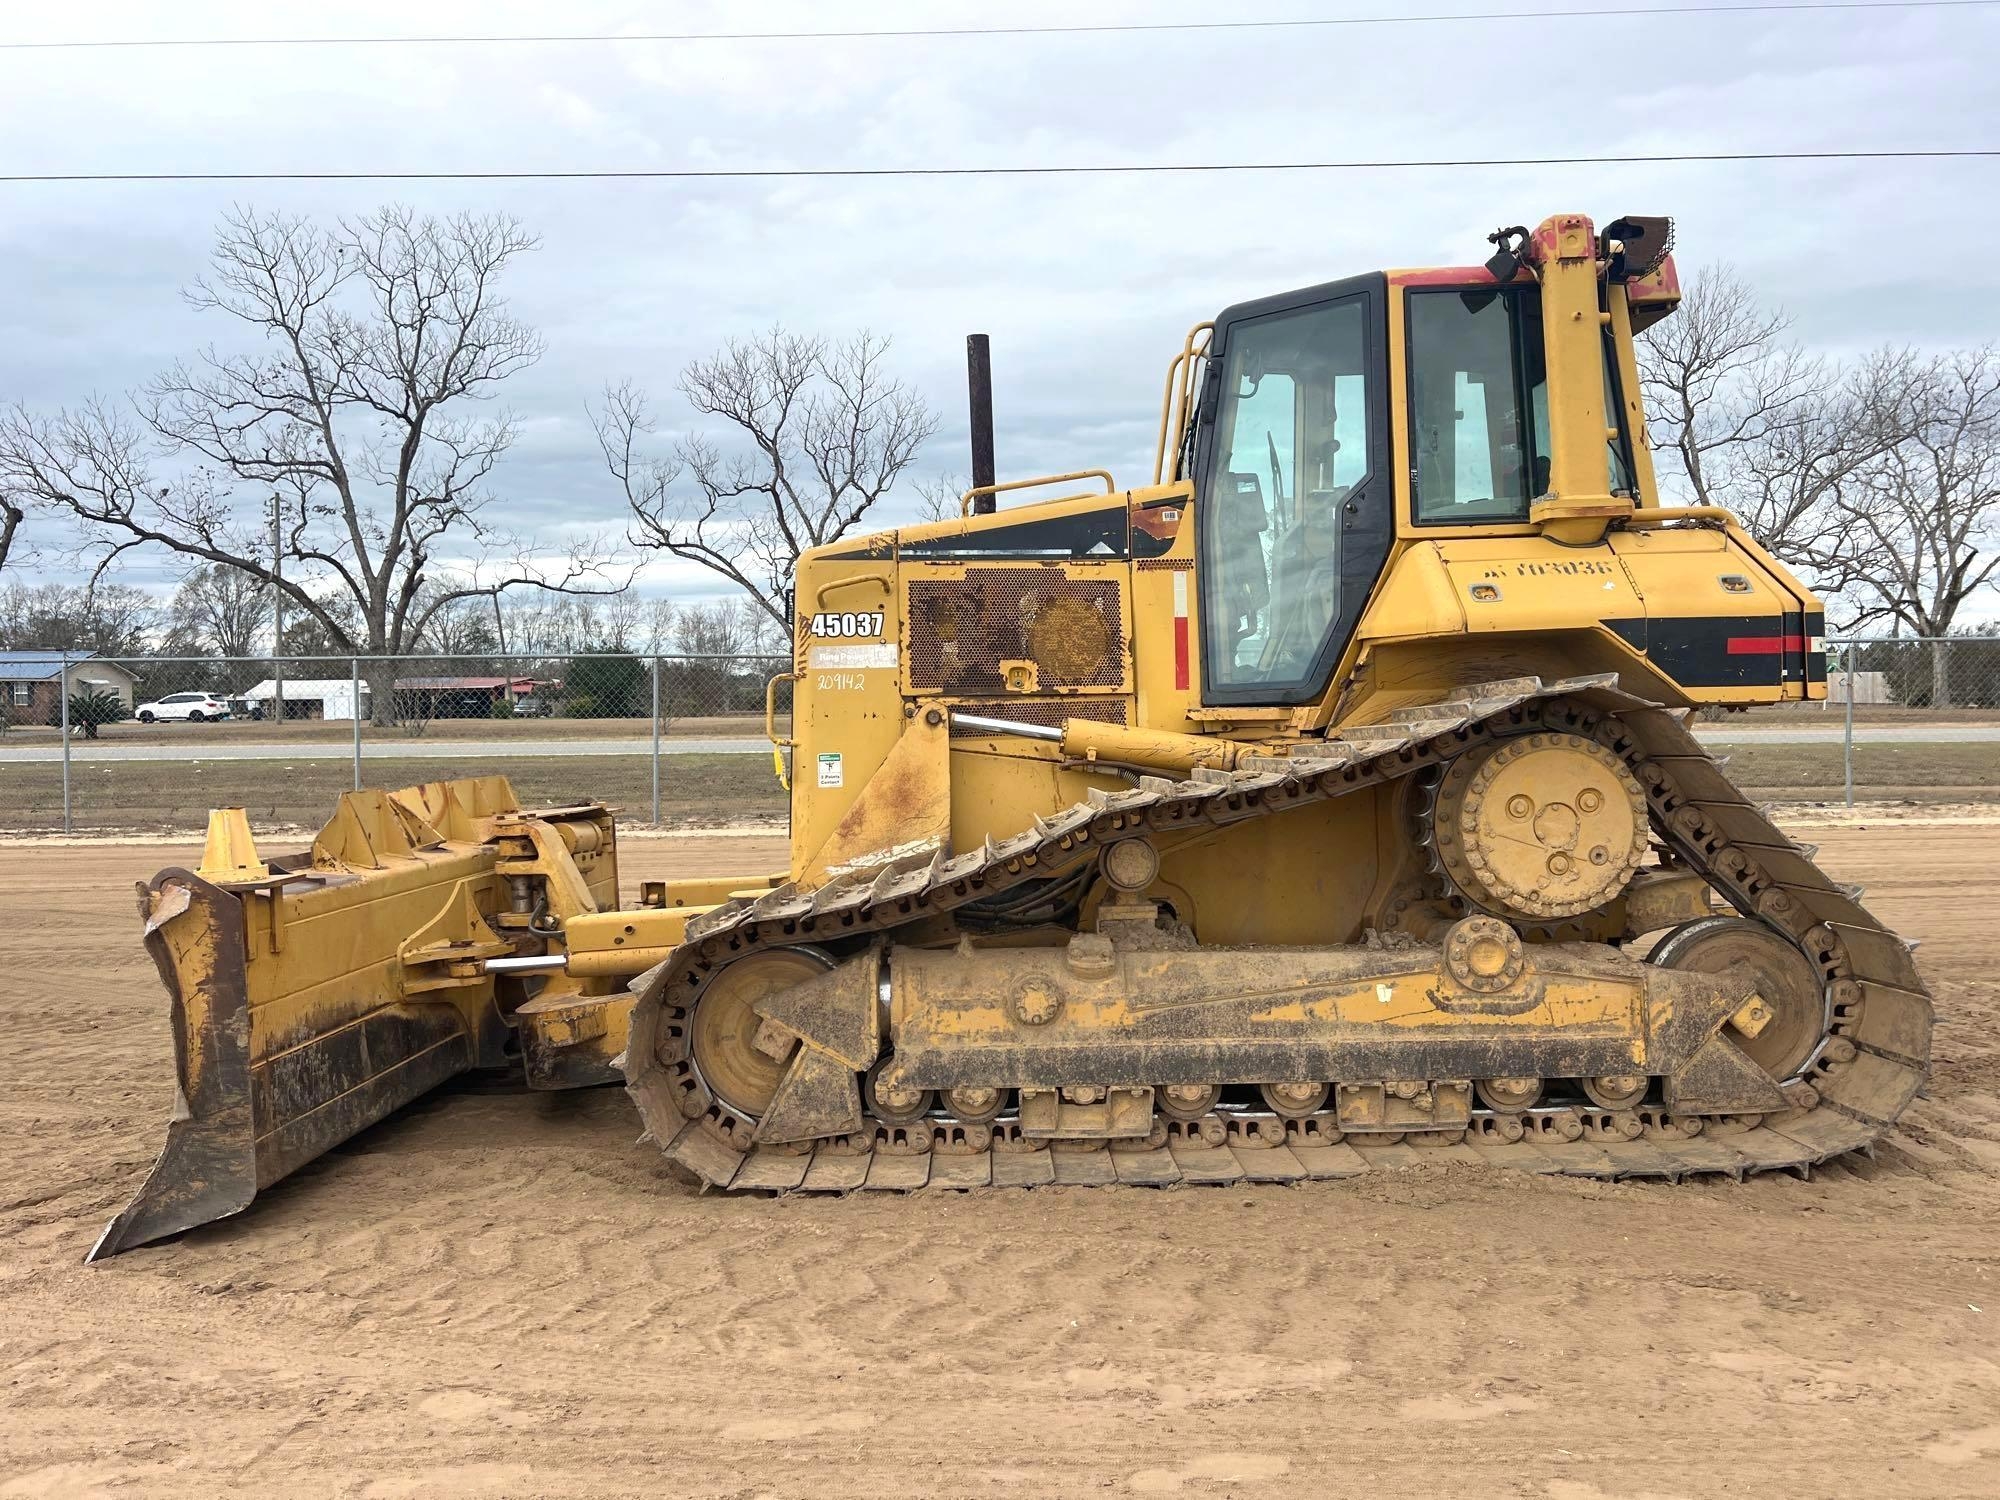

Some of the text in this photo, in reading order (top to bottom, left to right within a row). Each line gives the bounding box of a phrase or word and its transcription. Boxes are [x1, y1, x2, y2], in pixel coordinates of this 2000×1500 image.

[811, 612, 884, 637] 45037
[819, 652, 840, 663] Ring
[817, 673, 865, 690] 209142
